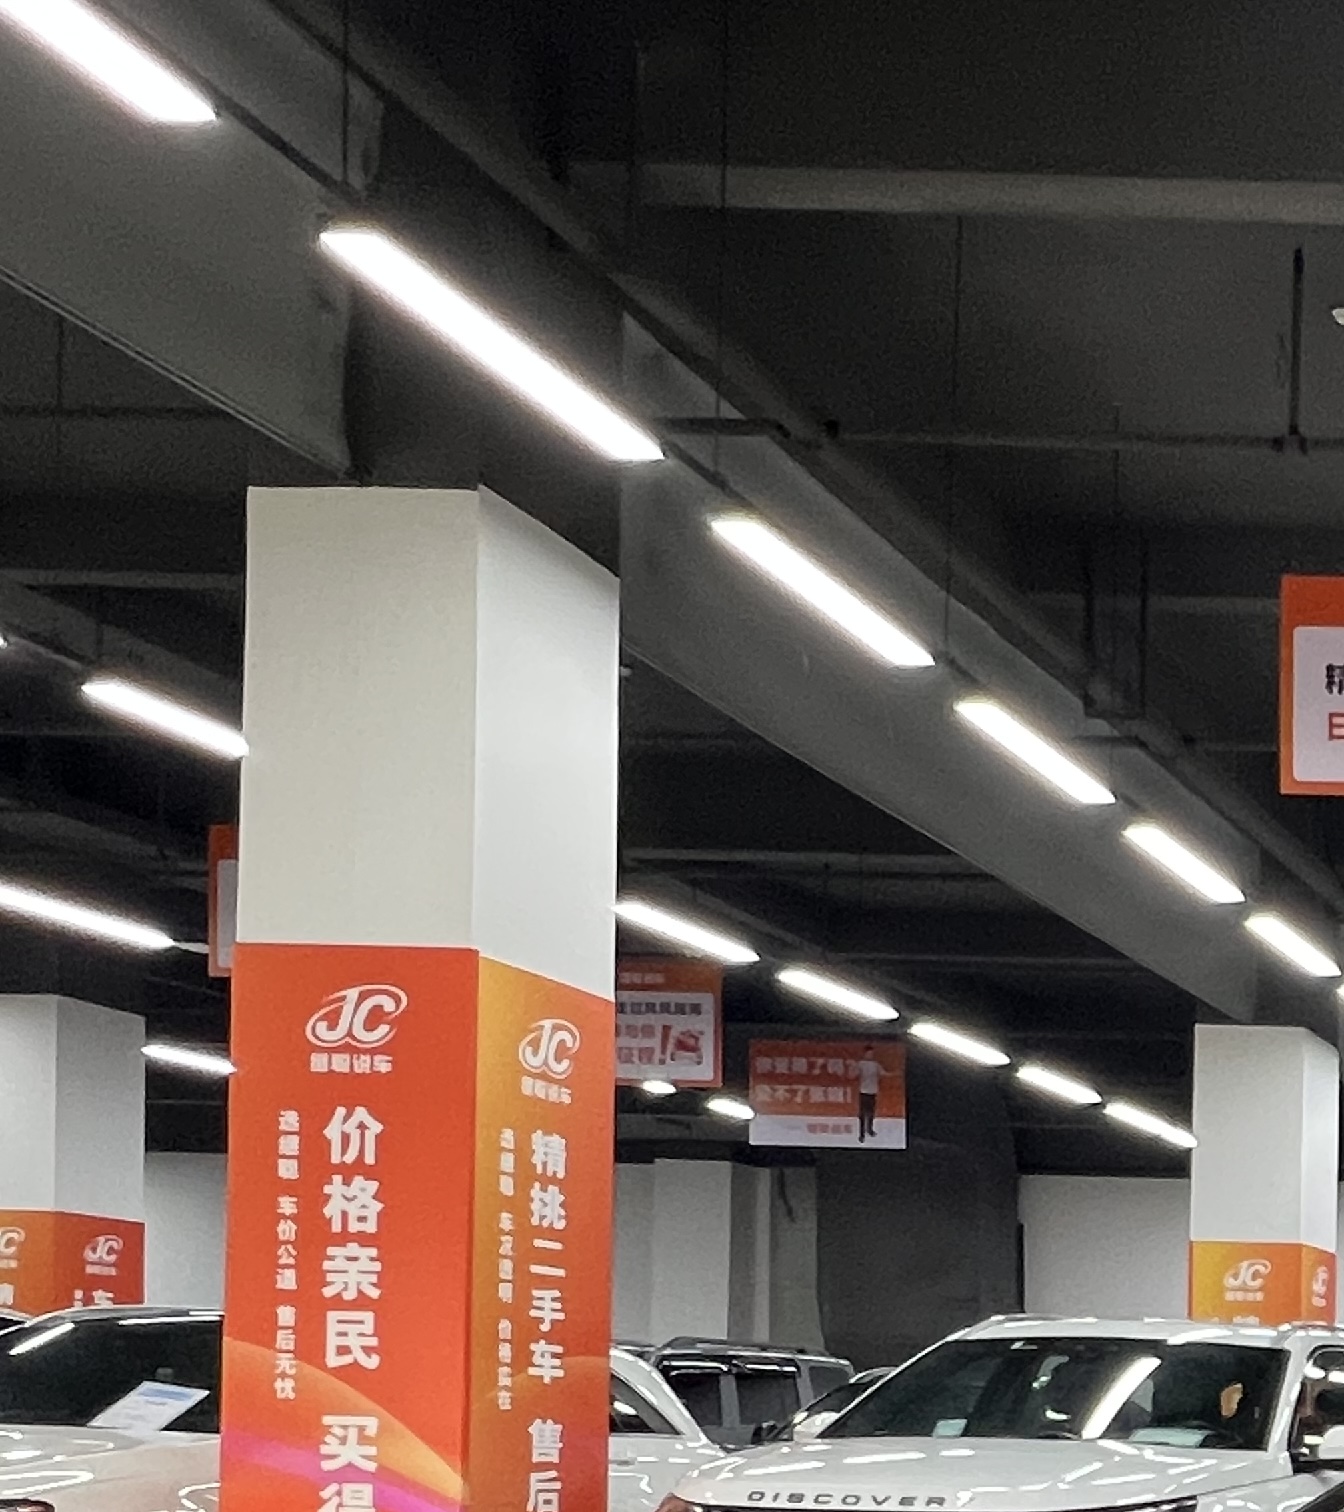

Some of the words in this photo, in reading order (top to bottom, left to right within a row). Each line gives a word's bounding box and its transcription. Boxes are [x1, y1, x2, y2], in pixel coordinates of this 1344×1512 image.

[309, 987, 402, 1045] JC
[521, 1020, 578, 1077] JC
[321, 1105, 385, 1370] 价格亲民
[528, 1129, 568, 1384] 精挑二手车
[1223, 1259, 1271, 1289] JC
